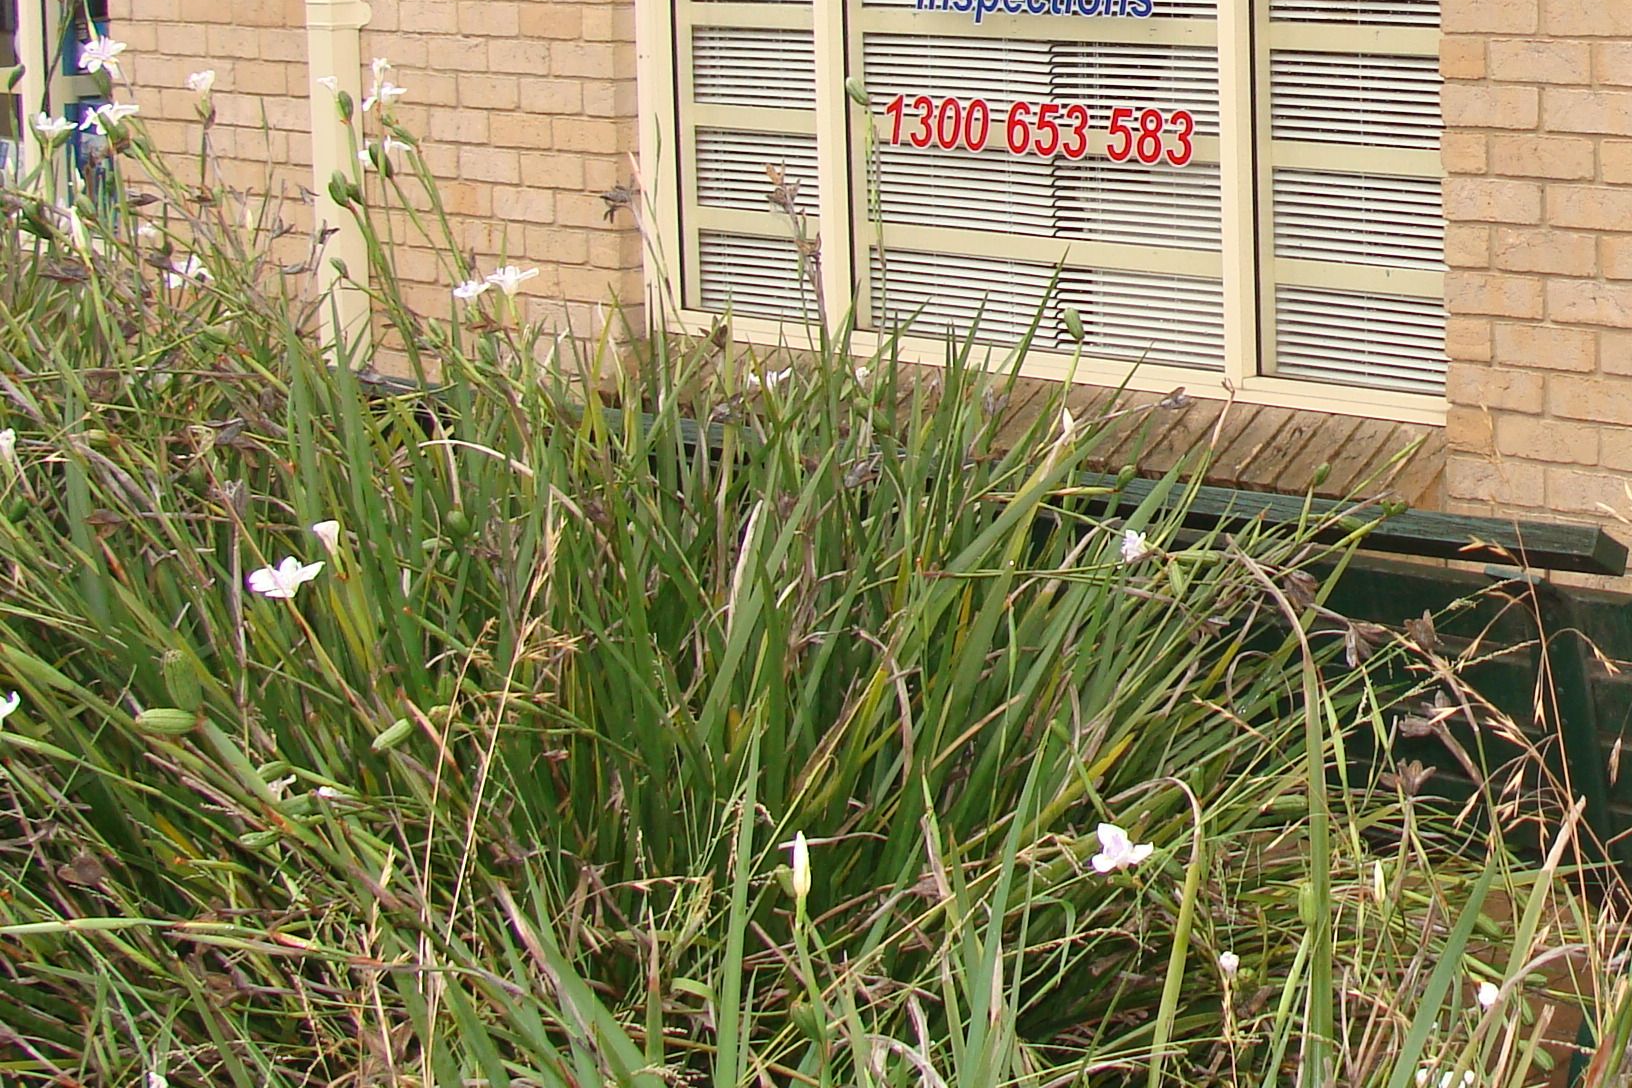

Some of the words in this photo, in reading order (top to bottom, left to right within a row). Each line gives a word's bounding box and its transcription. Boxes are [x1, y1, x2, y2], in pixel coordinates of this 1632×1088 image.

[884, 93, 990, 153] 1300
[1006, 101, 1089, 159] 653
[1106, 107, 1195, 168] 583
